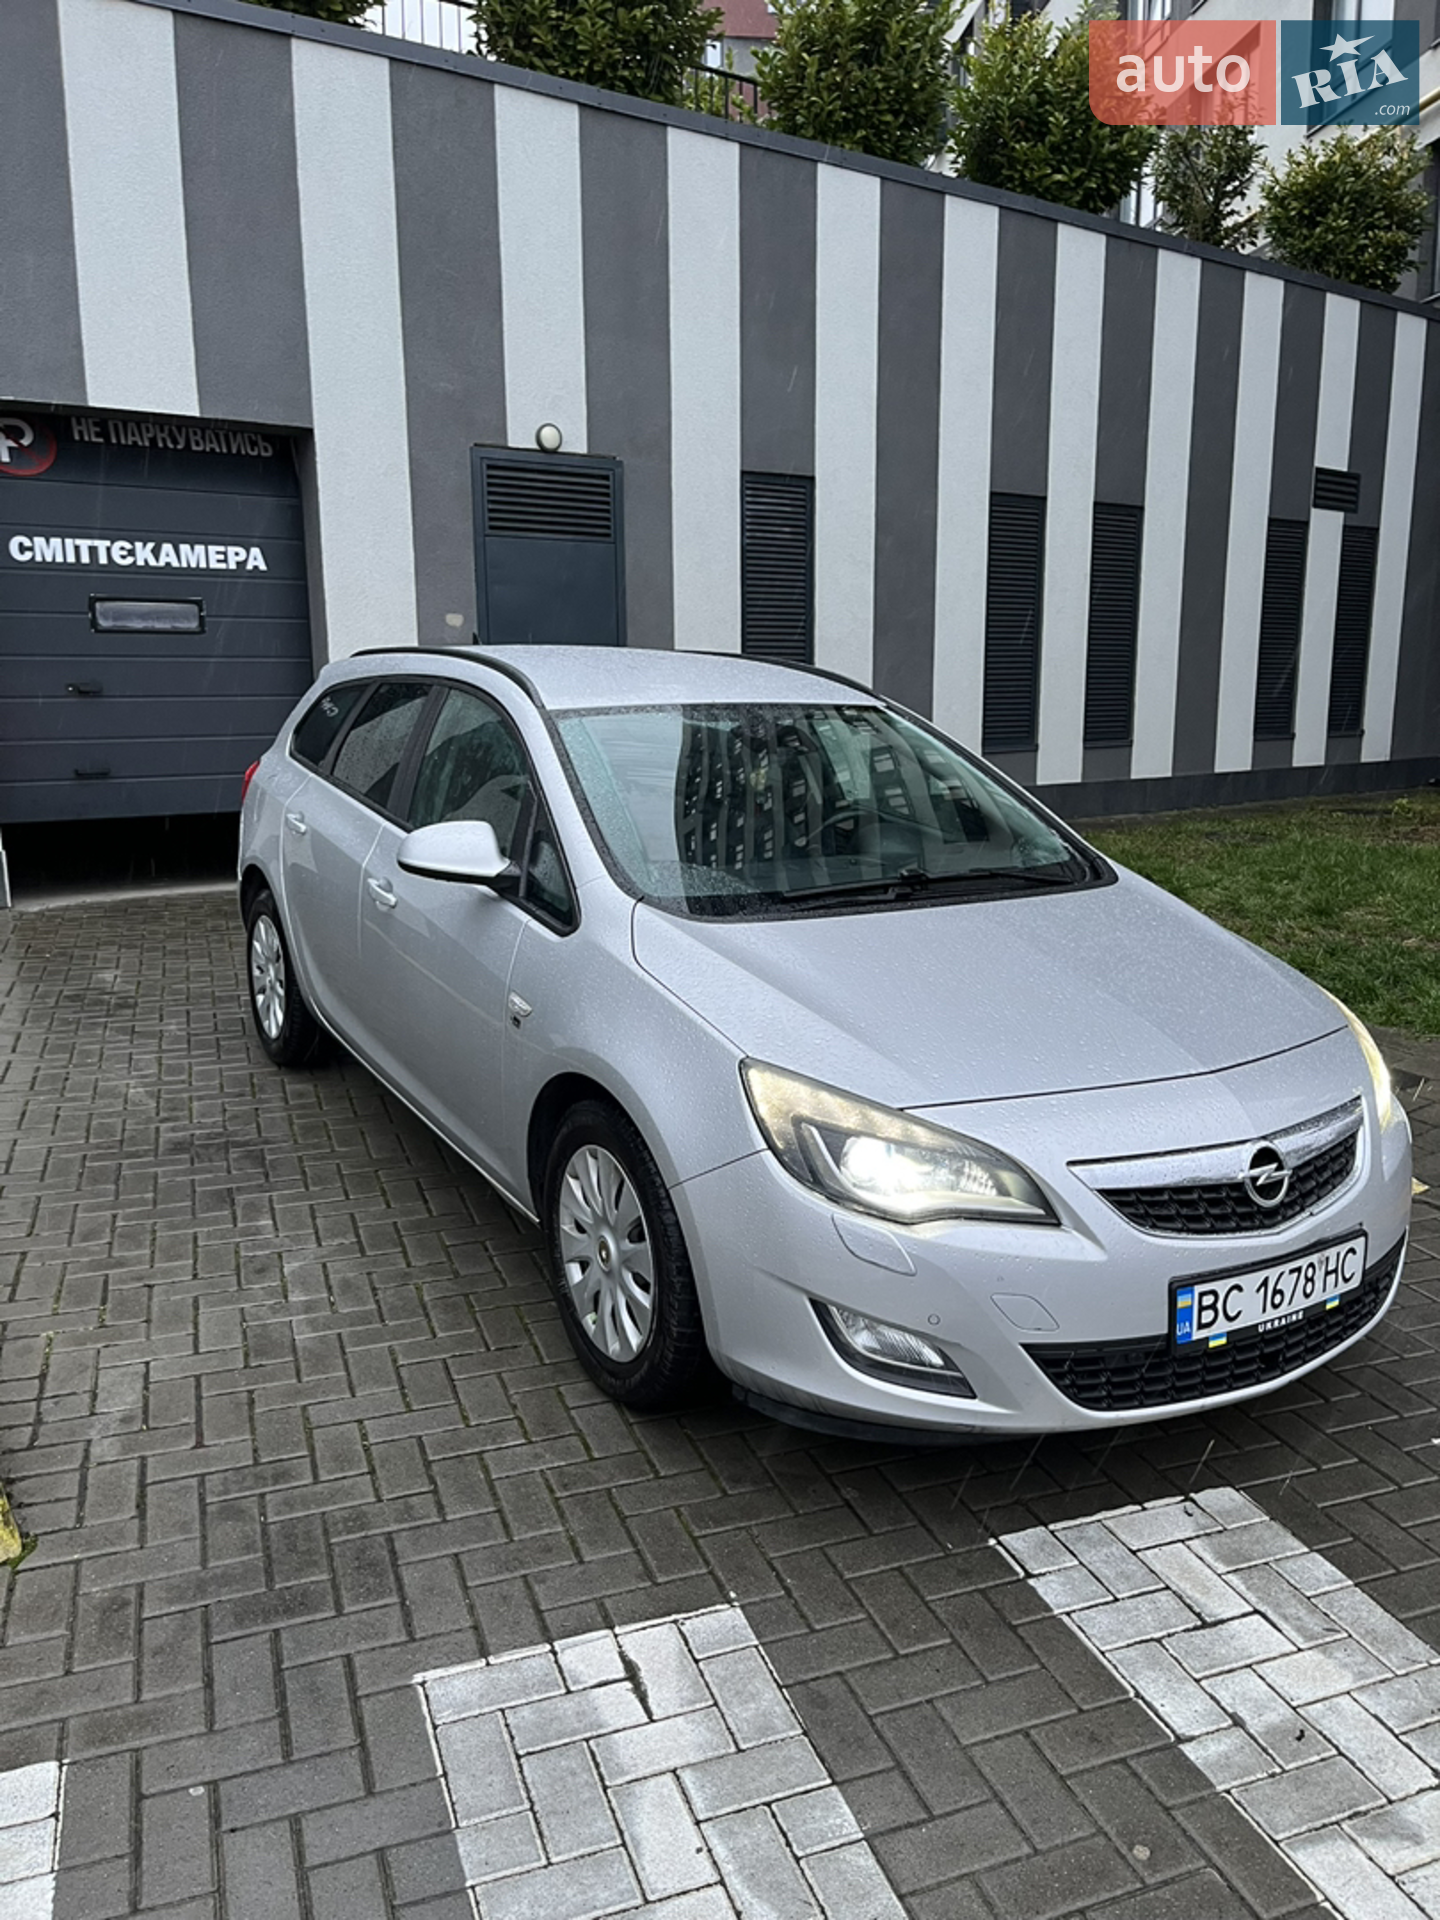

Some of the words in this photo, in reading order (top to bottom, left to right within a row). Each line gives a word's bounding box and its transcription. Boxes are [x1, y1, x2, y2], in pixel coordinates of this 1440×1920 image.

[70, 416, 104, 443] НЕ
[107, 419, 273, 458] ПАРКУВАТИСЬ
[8, 535, 268, 571] СМІТТЄКАМЕРА
[1196, 1283, 1244, 1331] BC
[1255, 1261, 1316, 1314] 1678
[1322, 1246, 1357, 1293] HC
[1176, 1320, 1191, 1336] UA
[1258, 1309, 1304, 1333] UKRAINE
